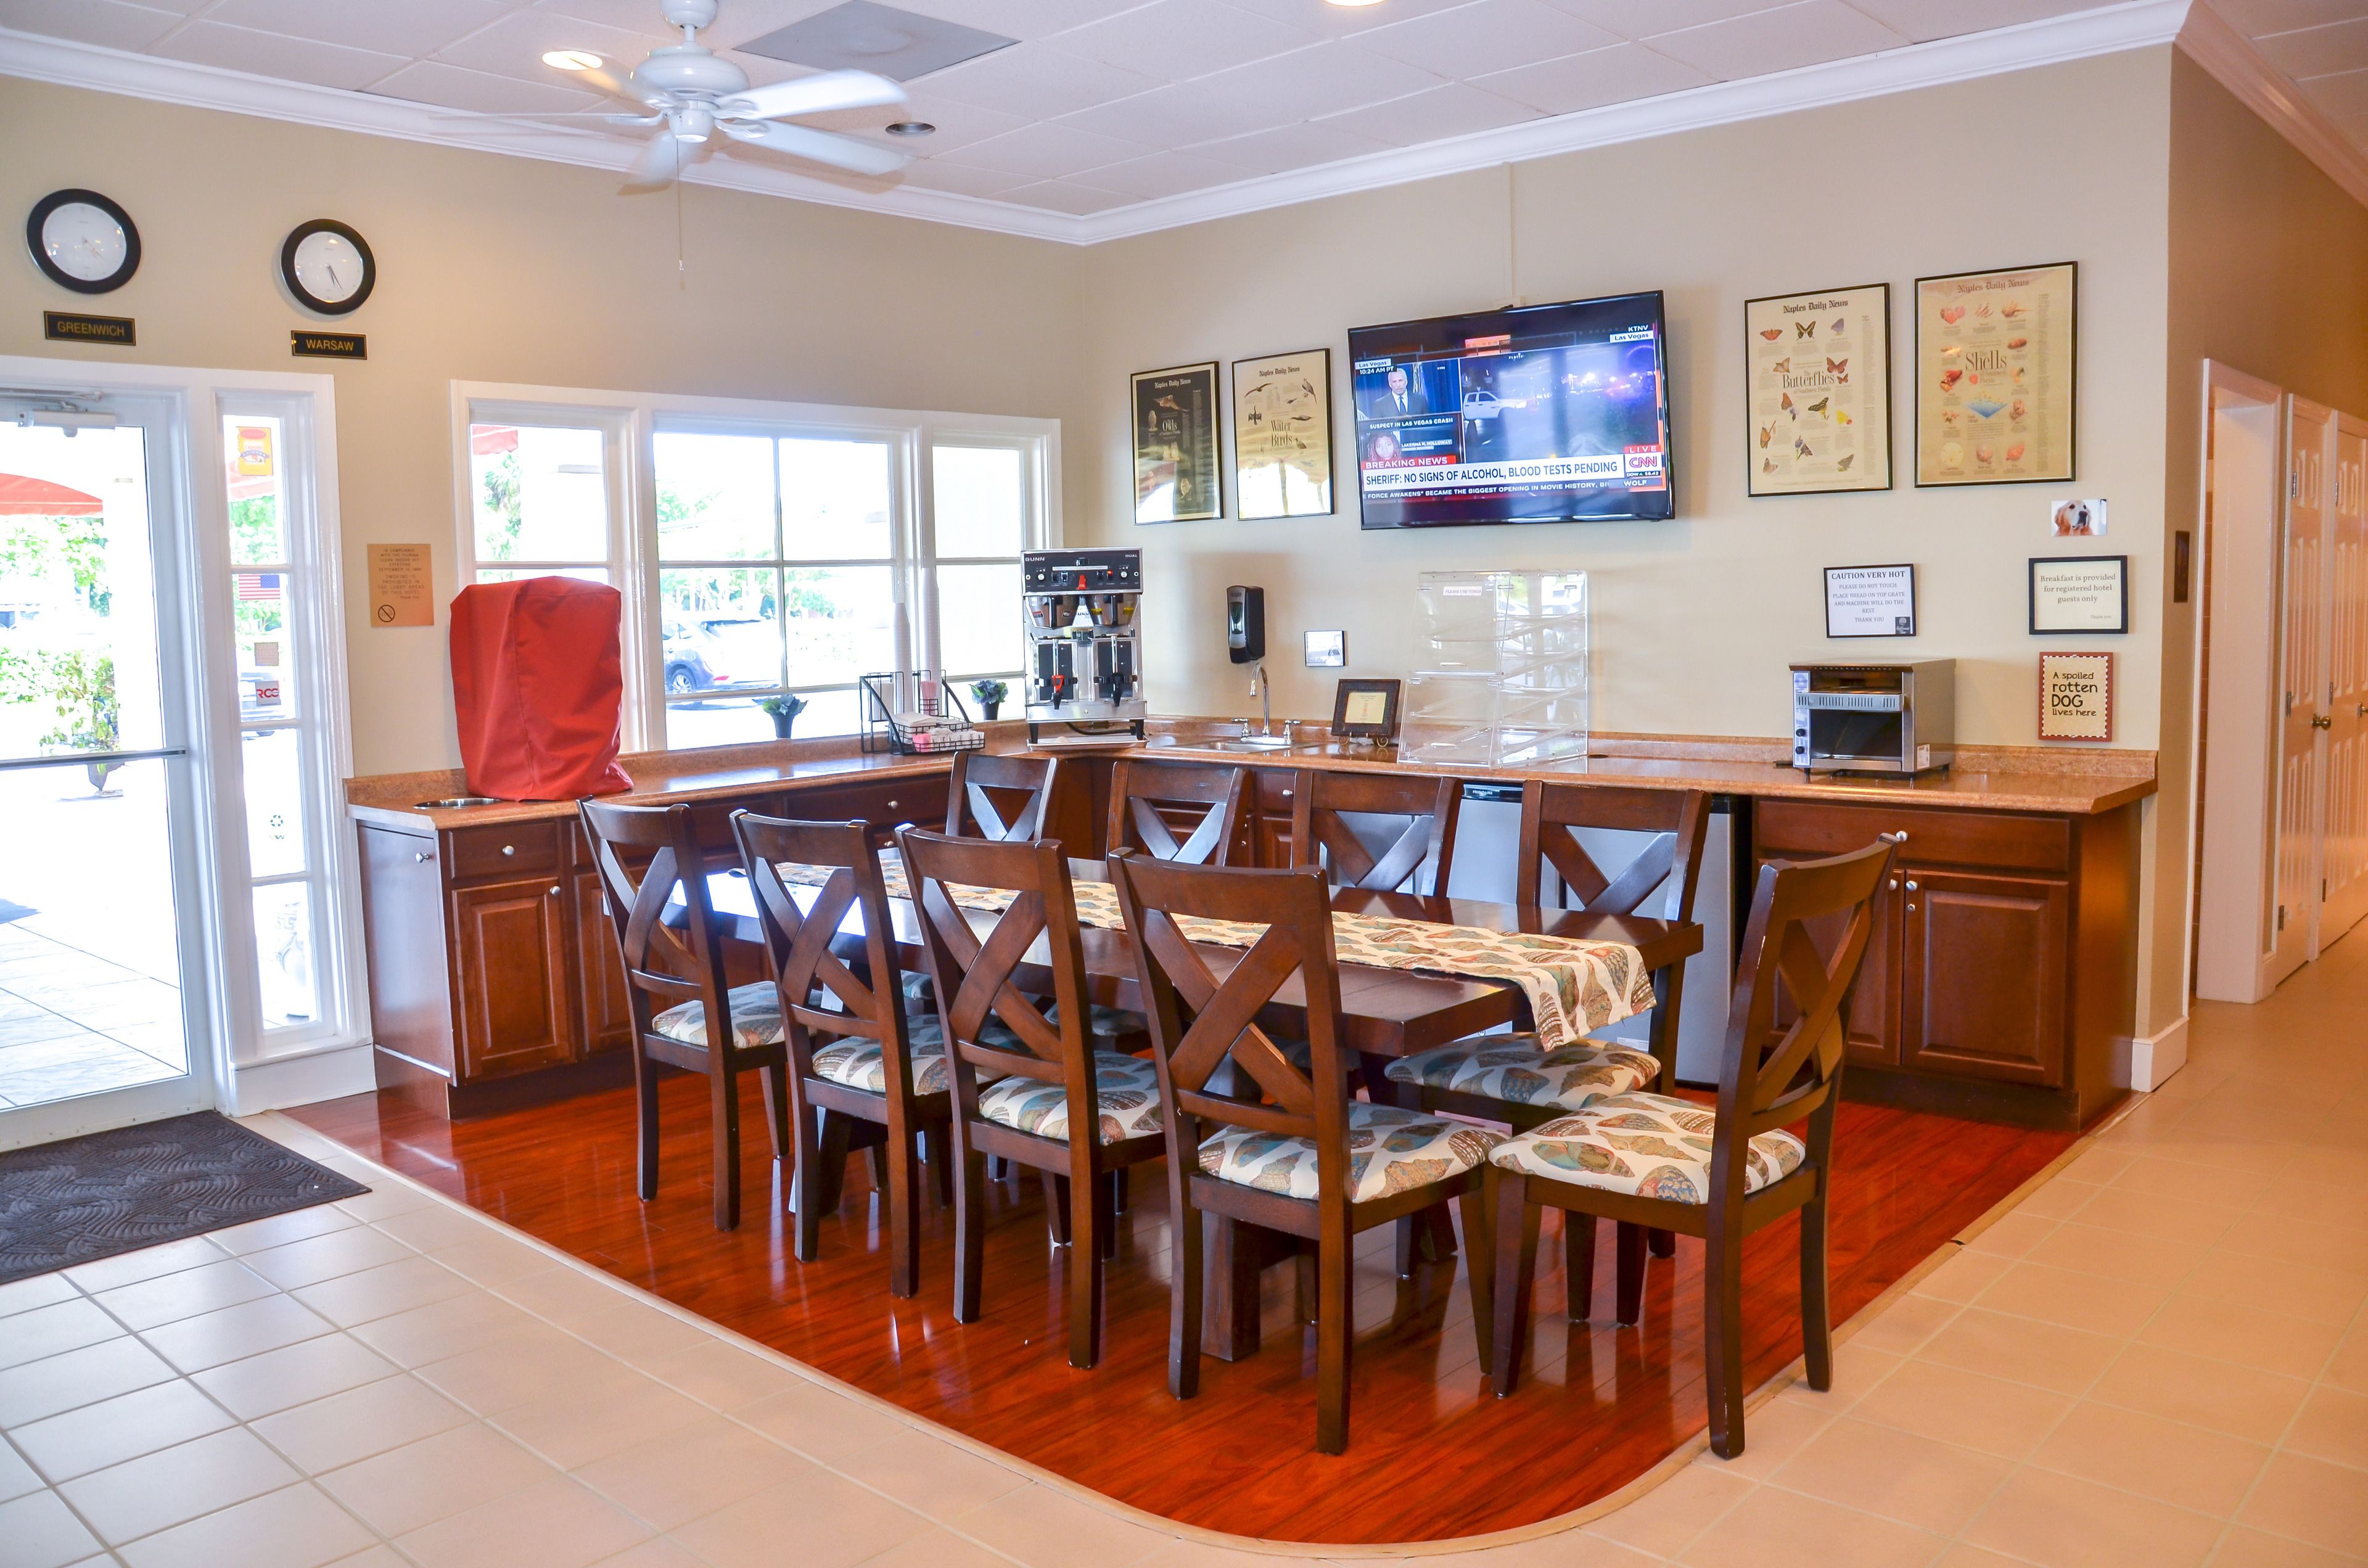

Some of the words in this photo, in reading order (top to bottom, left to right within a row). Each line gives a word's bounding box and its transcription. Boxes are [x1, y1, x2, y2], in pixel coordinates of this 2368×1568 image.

[1958, 284, 1983, 293] Naples
[1986, 281, 2005, 290] Daily
[2008, 279, 2029, 287] News
[1783, 304, 1806, 314] Naples
[1809, 302, 1827, 310] Daily
[57, 321, 125, 337] GREENWICH
[1628, 324, 1648, 332] KTNV
[1629, 332, 1649, 340] Vegas
[306, 339, 354, 351] WARSAW
[1965, 350, 2007, 371] Shells
[1783, 371, 1835, 388] Butterflies
[1162, 419, 1177, 431] Owls
[1271, 421, 1292, 432] Water
[1272, 432, 1292, 446] Birds
[1365, 459, 1415, 469] BREAKING
[1418, 457, 1447, 466] NEWS
[1629, 456, 1658, 468] CNN
[1367, 474, 1402, 485] SHERIFF:
[1404, 473, 1417, 483] NO
[1420, 472, 1444, 482] SIGNS
[1447, 470, 1458, 480] OF
[1461, 468, 1507, 480] ALCOHOL,
[1509, 466, 1541, 477] BLOOD
[1544, 464, 1572, 475] TESTS
[1575, 462, 1618, 474] PENDING
[1564, 482, 1598, 490] HISTORY,
[1867, 571, 1888, 579] VERY
[2083, 573, 2116, 583] provided
[2056, 585, 2092, 594] registered
[2057, 596, 2080, 604] guests
[2082, 595, 2098, 604] only
[2062, 672, 2094, 681] spoiled
[2052, 682, 2098, 692] rotten
[2052, 694, 2083, 707] DOG
